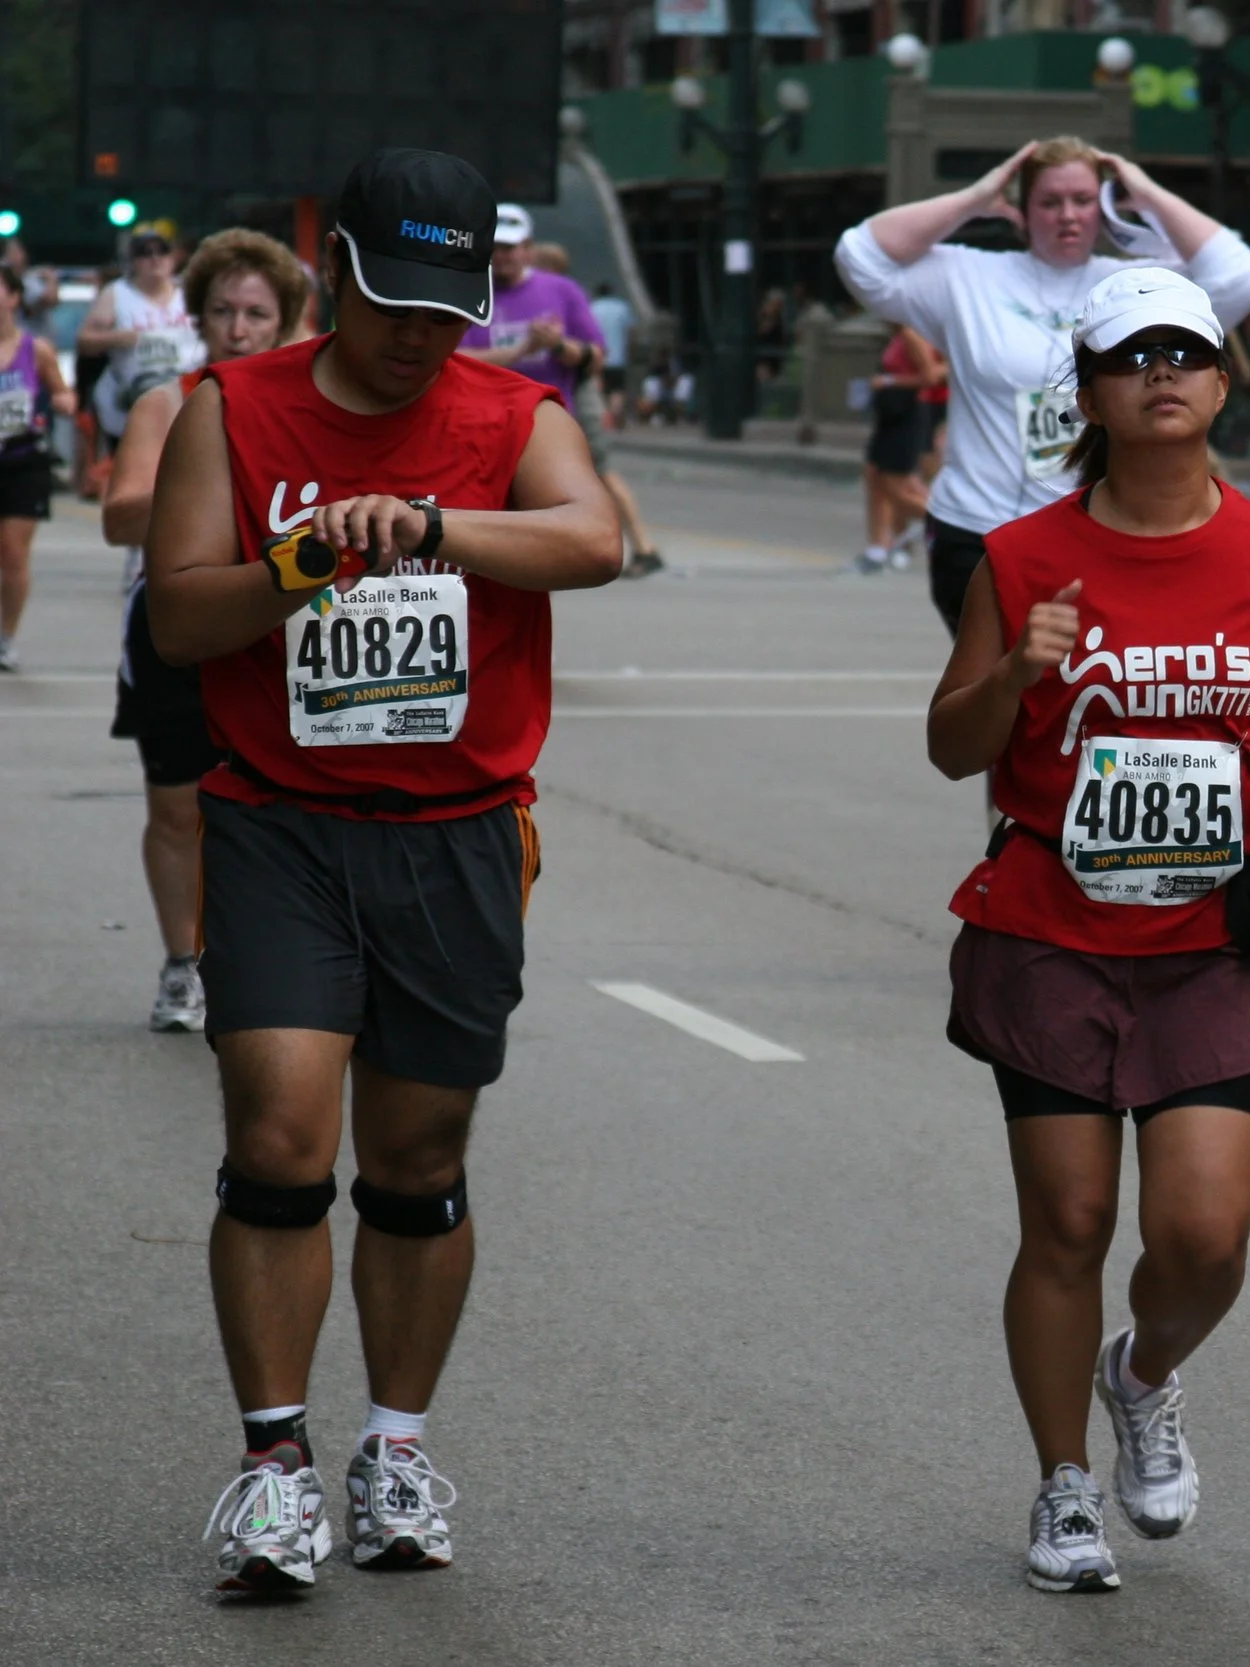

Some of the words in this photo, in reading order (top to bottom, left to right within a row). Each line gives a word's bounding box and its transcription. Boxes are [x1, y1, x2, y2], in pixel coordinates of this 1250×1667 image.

[400, 219, 474, 249] RUNCHI
[340, 589, 396, 604] LaSalle
[400, 587, 438, 602] Bank
[341, 608, 360, 617] ABN
[297, 614, 457, 680] 40829
[321, 692, 349, 708] 30th
[353, 678, 457, 703] ANNIVERSARY
[310, 723, 344, 734] October
[355, 722, 375, 732] 2007
[1124, 752, 1178, 768] LaSalle
[1182, 754, 1217, 769] Bank
[1123, 771, 1142, 780] ABN
[1075, 779, 1232, 847] 40835
[1092, 855, 1121, 868] 30th
[1126, 849, 1231, 866] ANNIVERSARY
[1125, 884, 1144, 893] 2007
